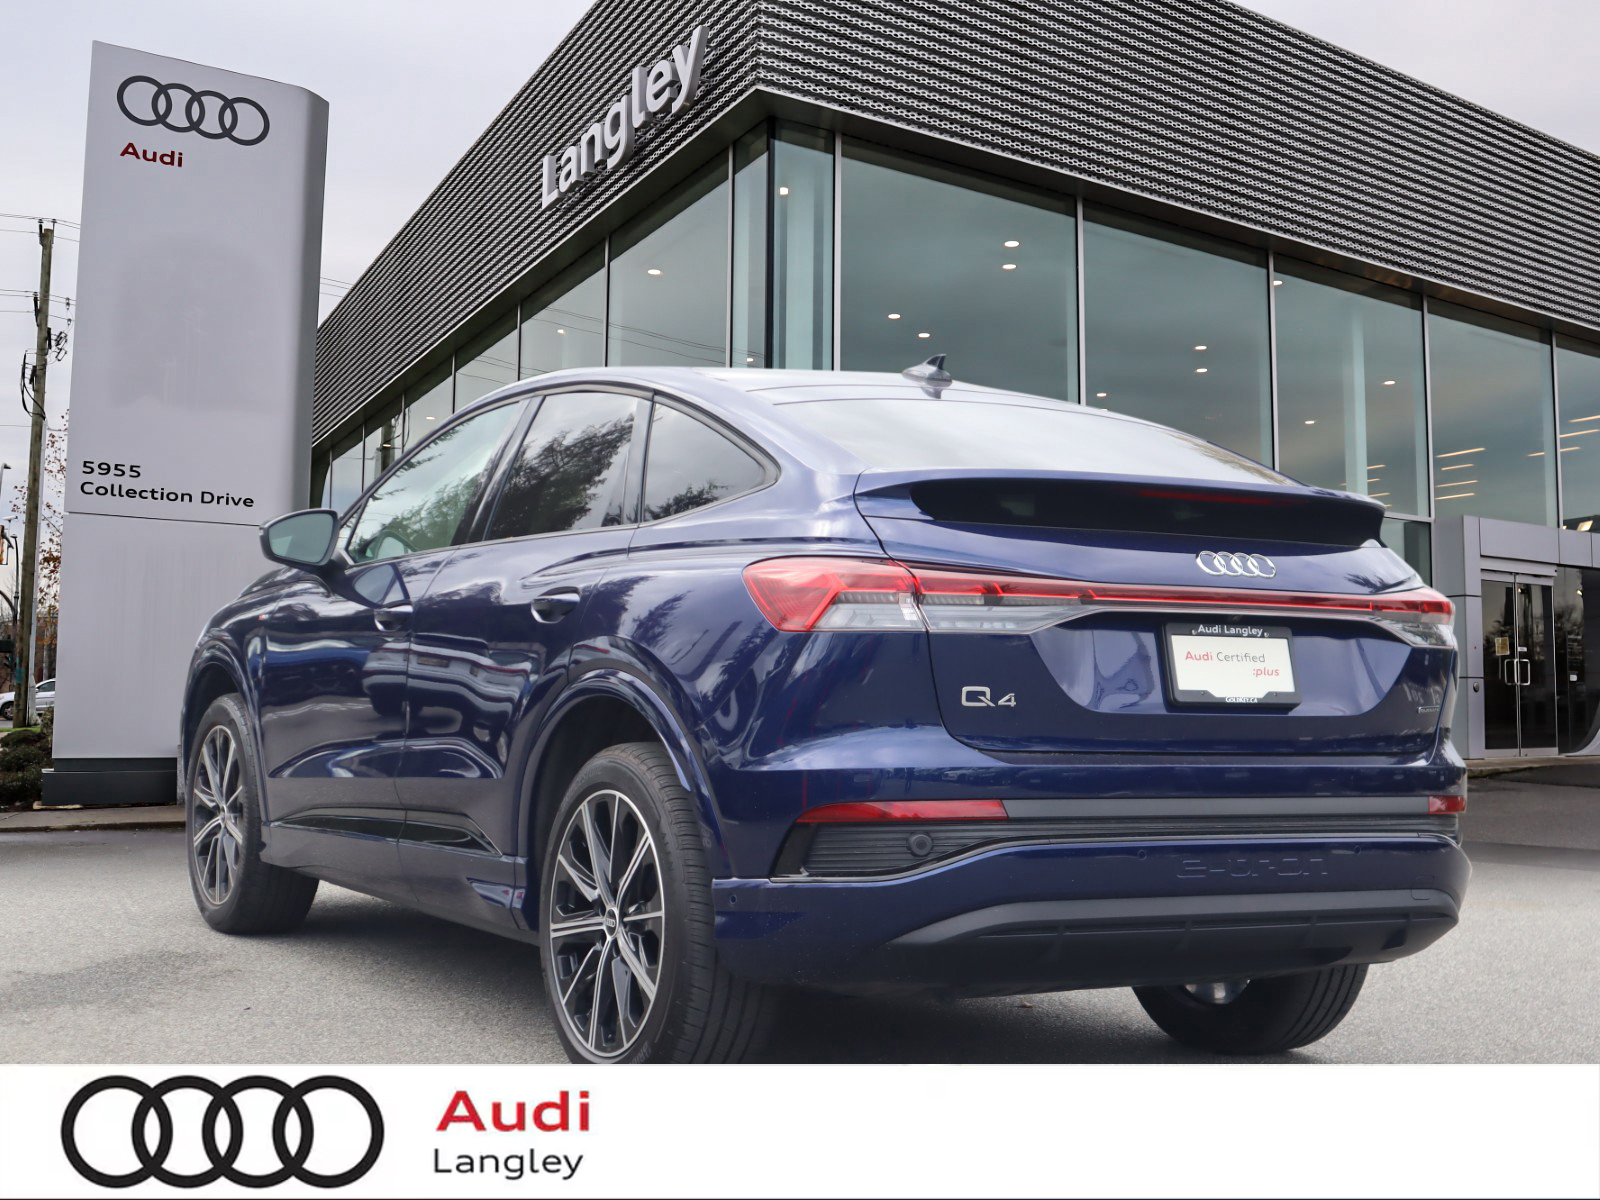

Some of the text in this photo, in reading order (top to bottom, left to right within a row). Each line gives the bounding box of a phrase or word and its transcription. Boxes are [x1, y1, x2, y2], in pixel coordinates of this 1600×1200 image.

[541, 25, 710, 210] Langley
[120, 142, 183, 168] Audi
[82, 460, 141, 479] 5955
[80, 481, 255, 508] Collection Drive
[1197, 624, 1264, 637] Audi Langley
[1185, 650, 1266, 663] Audi Certified
[961, 685, 1017, 707] Q4
